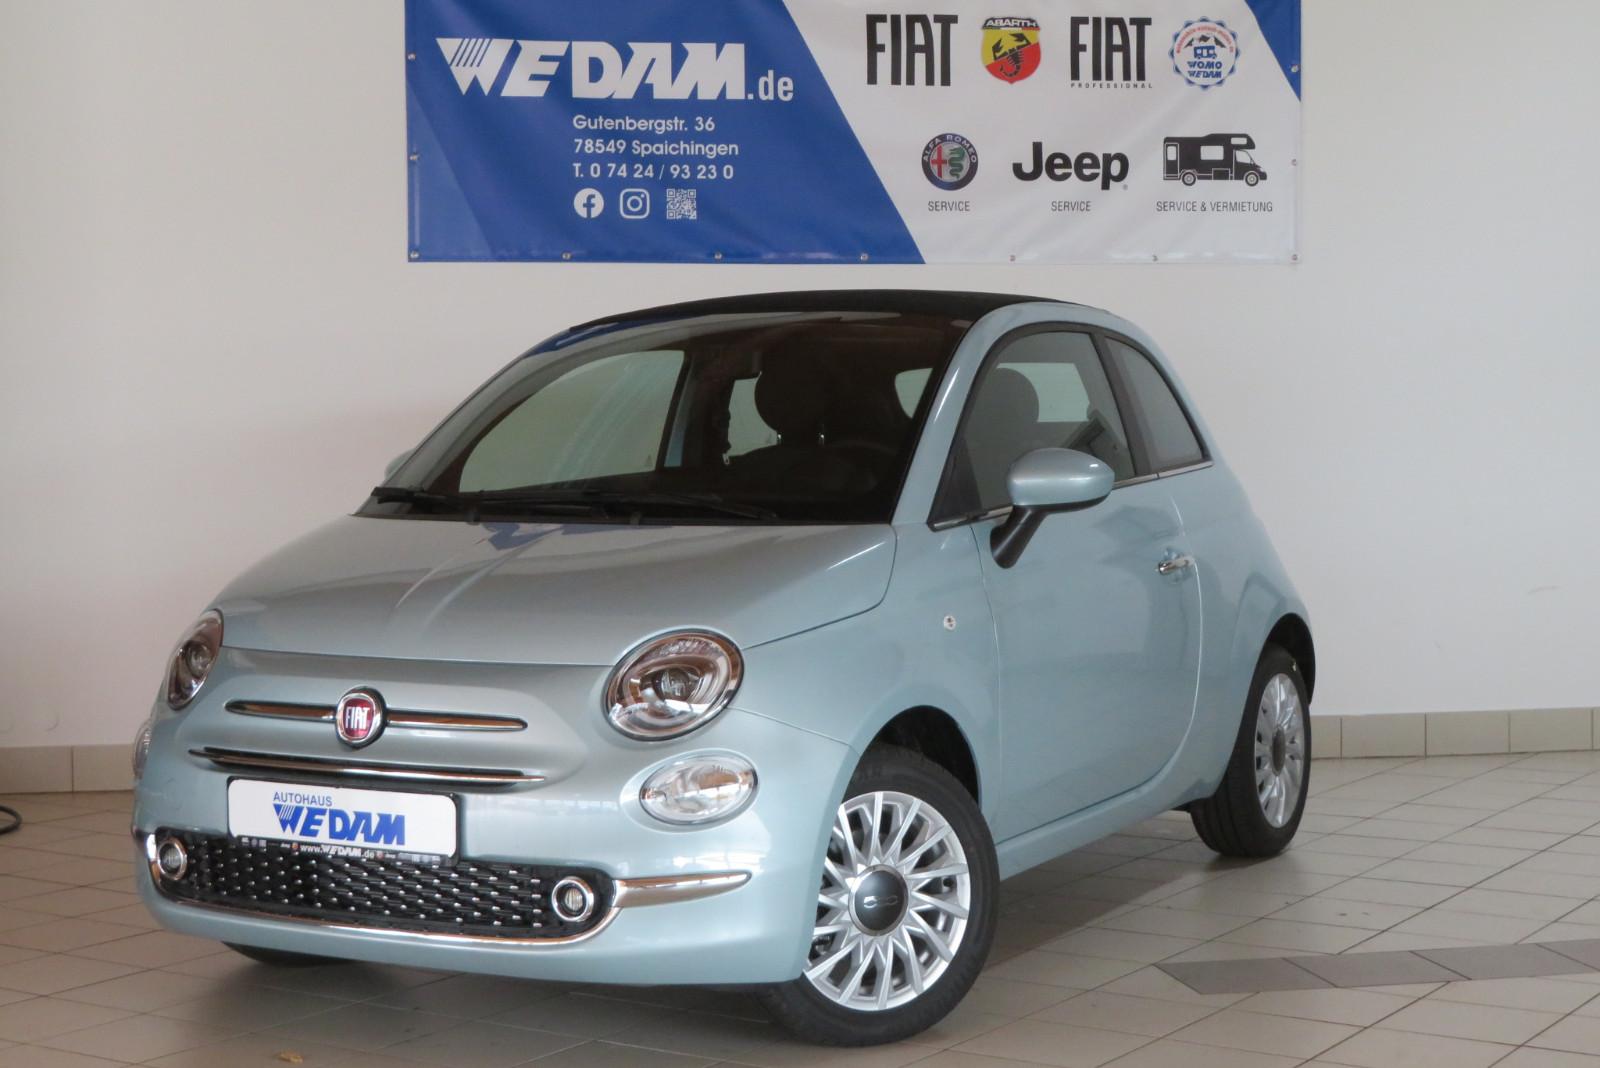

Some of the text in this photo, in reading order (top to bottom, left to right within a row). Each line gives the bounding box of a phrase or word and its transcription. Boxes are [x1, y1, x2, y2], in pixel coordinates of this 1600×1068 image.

[986, 19, 1036, 27] ABARTH
[866, 14, 958, 86] FIAT
[1070, 16, 1152, 81] FIAT
[1187, 61, 1222, 69] WOMO
[573, 115, 715, 133] Gutenbergstr. 36
[574, 139, 739, 156] 78549 Spaichingen
[923, 135, 977, 163] ALFA ROMEO
[573, 163, 583, 178] T.
[590, 164, 600, 178] 0
[607, 164, 627, 178] 74
[633, 165, 654, 178] 24
[670, 165, 691, 179] 93
[697, 165, 718, 179] 23
[723, 165, 734, 179] 0
[1012, 141, 1129, 190] Jeep
[928, 201, 970, 212] SERVICE
[1051, 201, 1091, 212] SERVICE
[1156, 201, 1273, 212] SERVICE & VERMIETUNG
[345, 706, 371, 730] FIAT
[273, 791, 333, 807] AUTOHAUS
[273, 803, 405, 846] WEDAM
